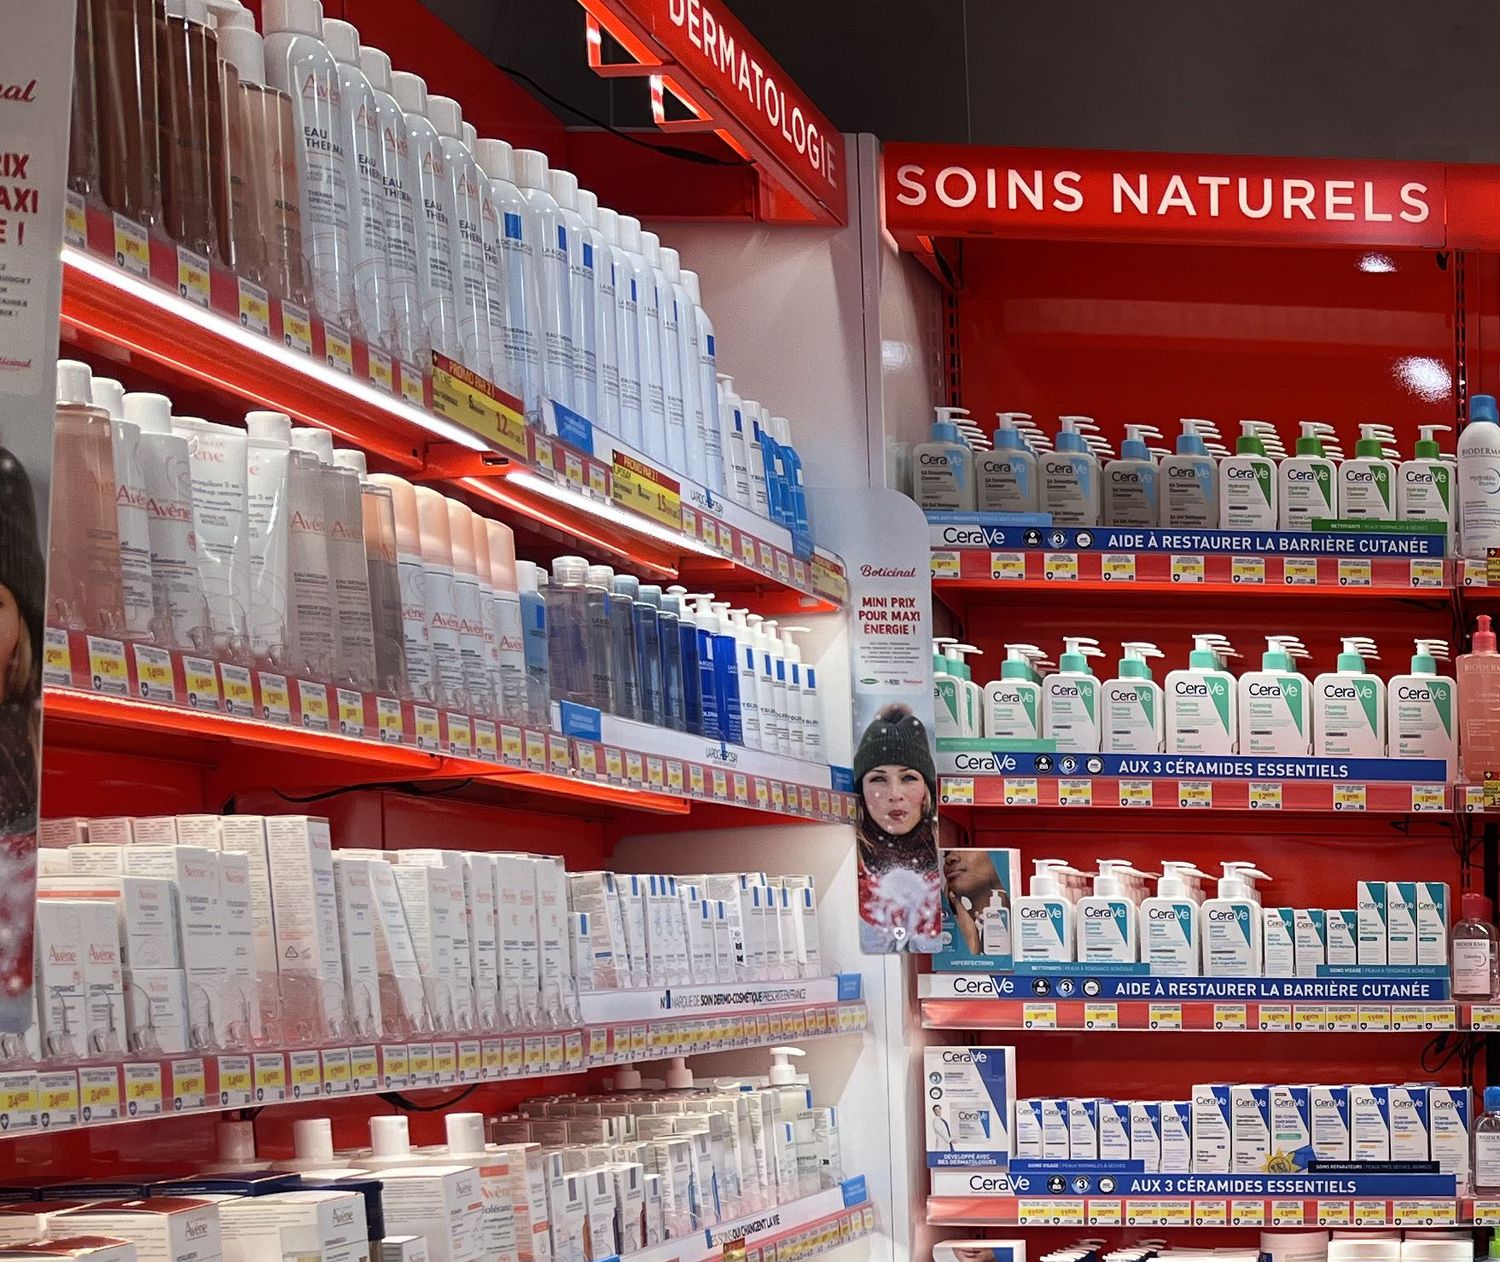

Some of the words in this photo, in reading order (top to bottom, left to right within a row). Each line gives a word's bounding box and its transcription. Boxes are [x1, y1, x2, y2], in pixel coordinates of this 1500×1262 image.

[669, 0, 838, 189] DERMATOLOGIE
[304, 126, 327, 140] EAU
[896, 165, 1084, 212] SOINS
[1114, 173, 1430, 222] NATURELS
[449, 362, 475, 384] PROMO
[920, 454, 961, 467] CeraVe
[984, 460, 1025, 474] CeraVe
[1112, 471, 1153, 484] CeraVe
[146, 499, 191, 521] Avène
[943, 527, 1005, 545] CeraVe
[1108, 535, 1144, 548] AIDE
[1148, 533, 1158, 549] À
[1162, 536, 1249, 551] RESTAURER
[1253, 537, 1275, 551] LA
[1279, 535, 1355, 553] BARRIÈRE
[1359, 536, 1428, 554] CUTANÉE
[861, 564, 916, 577] Boticinal
[863, 597, 887, 607] MINI
[891, 598, 915, 608] PRIX
[859, 611, 887, 620] POUR
[892, 612, 920, 621] MAXI
[864, 622, 908, 634] ÉNERGIE
[1051, 684, 1092, 697] CeraVe
[1111, 690, 1152, 702] CeraVe
[1175, 682, 1224, 697] CeraVe
[1249, 683, 1298, 698] CeraVe
[1324, 684, 1372, 699] CeraVe
[1399, 686, 1446, 701] CeraVe
[993, 691, 1034, 704] CeraVe
[955, 754, 1016, 772] CeraVe
[1119, 761, 1149, 775] AUX
[1153, 762, 1162, 775] 3
[1166, 759, 1252, 777] CÉRAMIDES
[1257, 763, 1348, 778] ESSENTIELS
[1021, 907, 1062, 920] CeraVe
[1084, 906, 1125, 919] CeraVe
[1149, 908, 1190, 921] CeraVe
[1209, 909, 1248, 922] CeraVe
[48, 945, 80, 963] Avène
[88, 945, 118, 963] Avène
[953, 977, 1014, 995] CeraVe
[1115, 982, 1151, 995] AIDE
[1155, 978, 1166, 996] À
[1169, 983, 1256, 996] RESTAURER
[1260, 984, 1281, 996] LA
[1284, 980, 1357, 997] BARRIÈRE
[1361, 980, 1430, 997] CUTANÉE
[943, 1051, 987, 1063] CeraVe
[969, 1175, 1030, 1193] CeraVe
[1131, 1180, 1161, 1193] AUX
[1165, 1180, 1173, 1193] 3
[1177, 1177, 1263, 1194] CÉRAMIDES
[1267, 1180, 1356, 1193] ESSENTIELS
[185, 1222, 208, 1239] Avène
